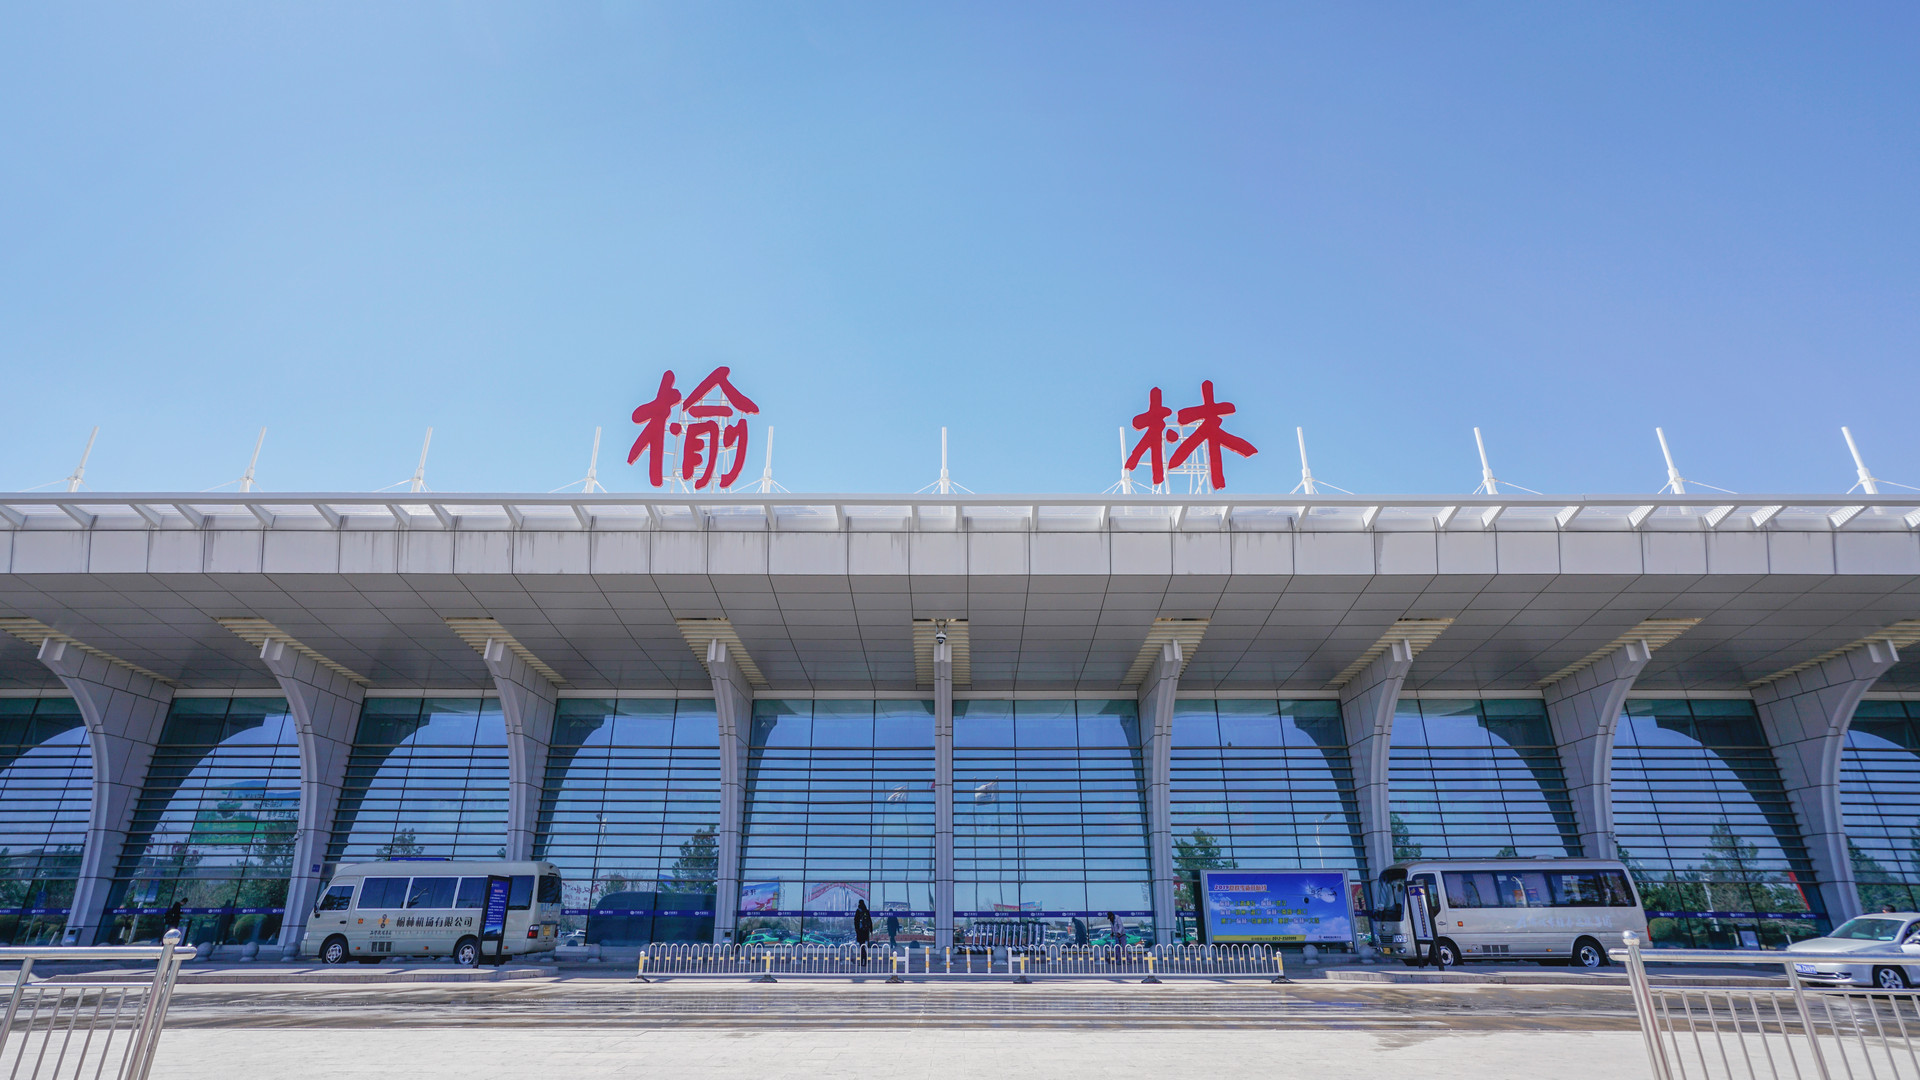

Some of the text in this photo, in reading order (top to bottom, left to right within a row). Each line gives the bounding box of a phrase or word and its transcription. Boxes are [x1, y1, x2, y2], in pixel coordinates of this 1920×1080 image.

[627, 366, 1258, 490] 榆 林
[396, 916, 473, 928] 榆林机场有限公司
